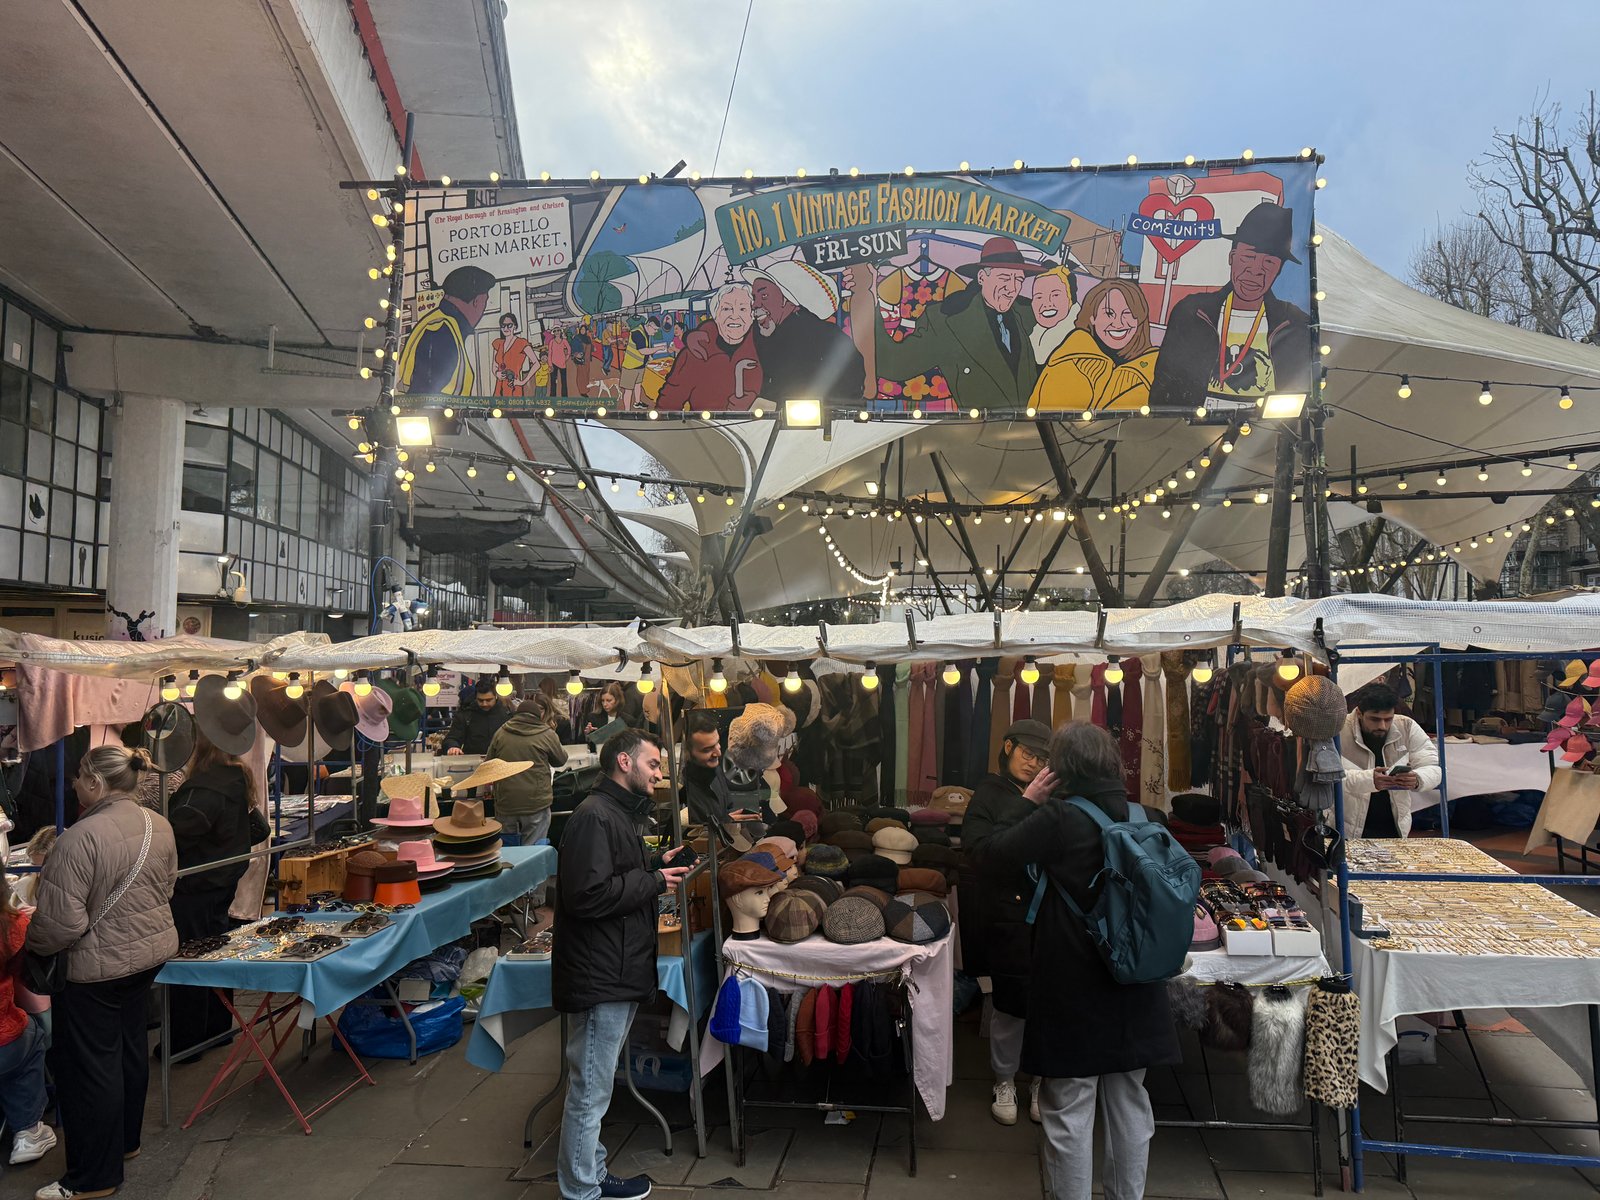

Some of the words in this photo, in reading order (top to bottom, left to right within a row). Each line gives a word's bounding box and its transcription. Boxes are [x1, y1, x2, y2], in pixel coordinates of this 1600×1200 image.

[434, 216, 446, 224] The
[446, 215, 463, 225] Royal
[464, 211, 487, 221] Borough
[489, 209, 496, 217] of
[497, 206, 527, 216] Kensington
[529, 204, 540, 212] and
[449, 216, 550, 243] PORTOBELLO
[771, 201, 788, 243] 1
[787, 189, 871, 238] VINTAGE
[876, 182, 961, 223] FASHION
[964, 191, 1061, 246] MARKET
[438, 243, 490, 264] GREEN
[494, 232, 567, 256] MARKET,
[814, 228, 902, 265] FRI-SUN
